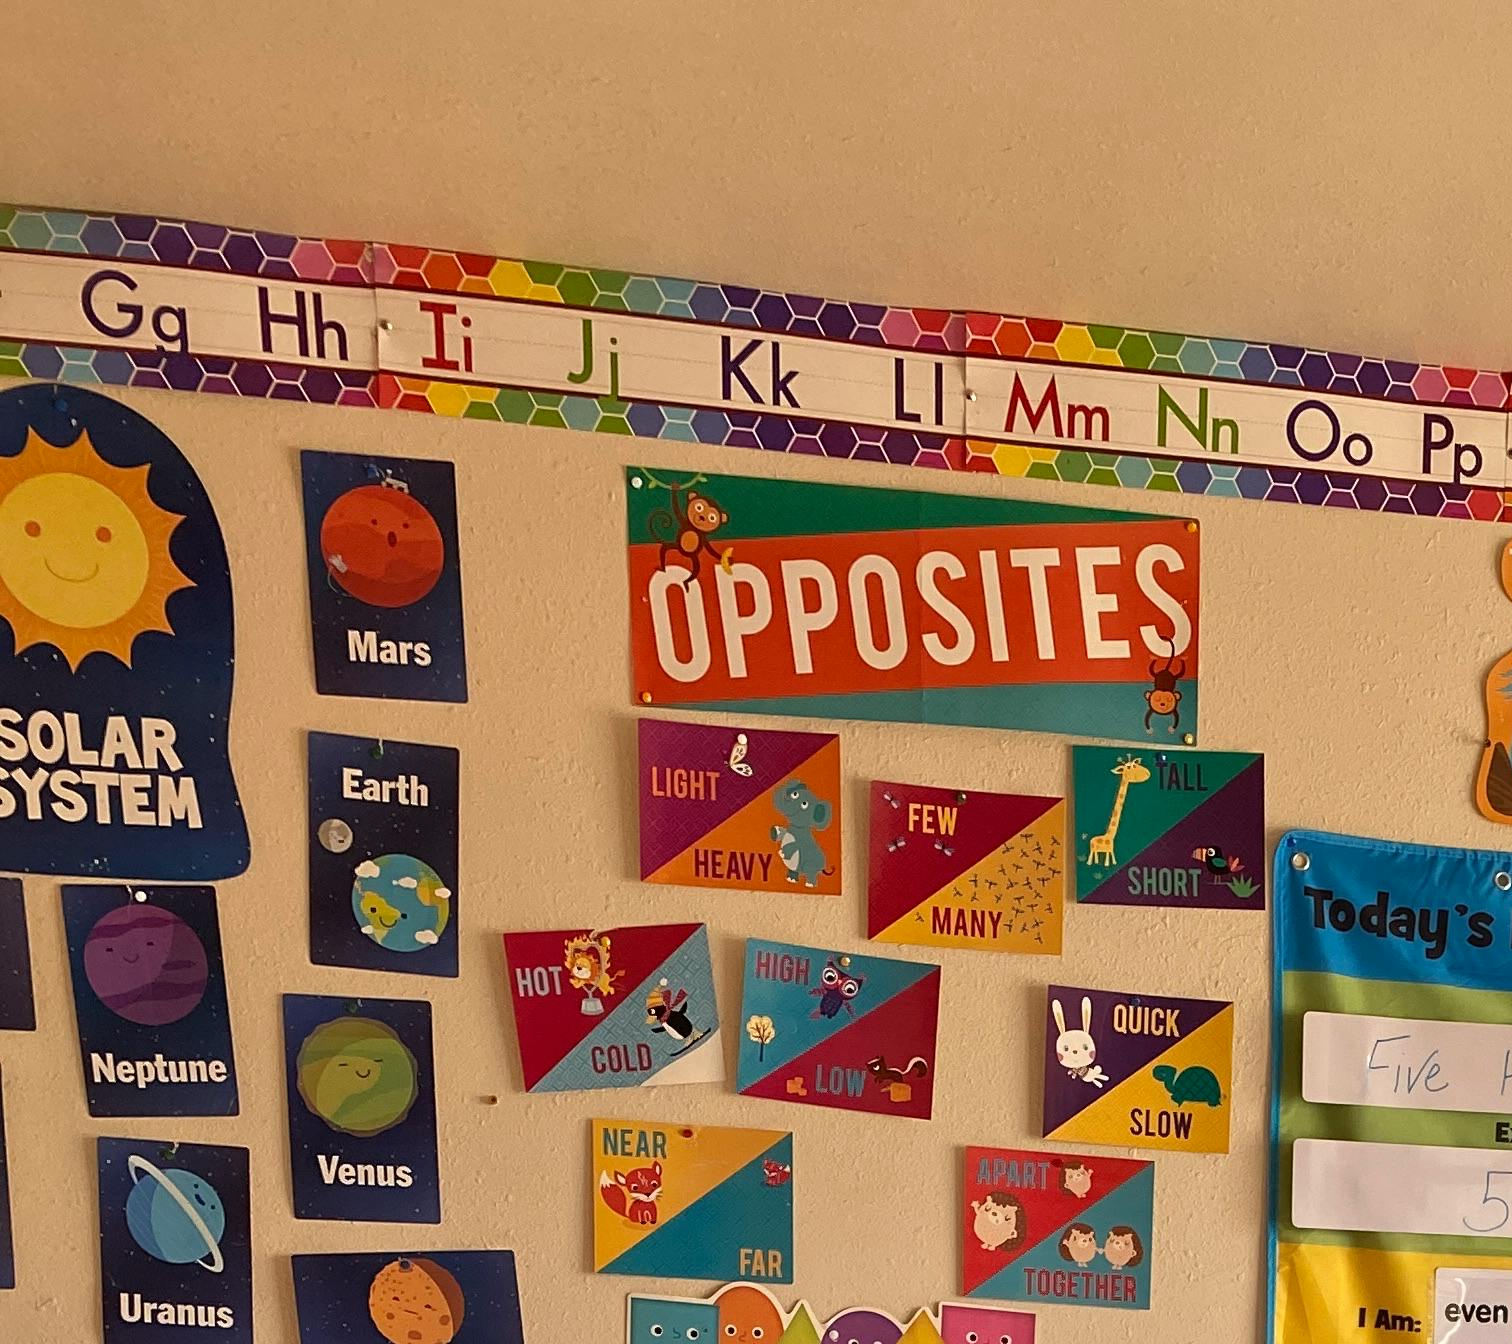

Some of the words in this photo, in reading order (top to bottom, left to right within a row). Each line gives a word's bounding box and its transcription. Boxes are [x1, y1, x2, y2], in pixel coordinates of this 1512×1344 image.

[82, 270, 188, 358] Gg
[258, 286, 348, 362] Hh
[420, 301, 474, 373] Ii
[567, 318, 619, 401] Jj
[721, 336, 800, 408] Kk
[895, 358, 943, 426] Ll
[1004, 370, 1110, 442] Mm
[1157, 383, 1239, 454] Nn
[1286, 400, 1373, 466] Oo
[1422, 413, 1483, 483] Pp
[648, 544, 1192, 682] OPPOSITES
[347, 630, 432, 667] Mars
[0, 707, 184, 772] SOLAR
[342, 768, 429, 807] Earth
[651, 766, 720, 801] LIGHT
[1155, 761, 1208, 792] TALL
[908, 803, 958, 836] FEW
[694, 848, 772, 882] HEAVY
[1128, 866, 1201, 897] SHORT
[931, 906, 1002, 939] MANY
[1303, 885, 1495, 960] Today's
[515, 966, 562, 997] HOT
[755, 951, 810, 985] HIGH
[1113, 1004, 1180, 1038] QUICK
[90, 1053, 228, 1089] Neptune
[592, 1043, 652, 1073] COLD
[1367, 1035, 1449, 1094] Five
[816, 1064, 866, 1097] LOW
[1129, 1108, 1192, 1140] SLOW
[602, 1127, 667, 1159] NEAR
[317, 1155, 413, 1188] Venus
[976, 1158, 1049, 1190] APART
[739, 1248, 783, 1278] FAR
[1024, 1267, 1136, 1303] TOGETHER
[119, 1293, 234, 1328] Uranus
[1358, 1308, 1366, 1328] I
[1375, 1308, 1422, 1333] Am:
[1444, 1302, 1509, 1324] even
